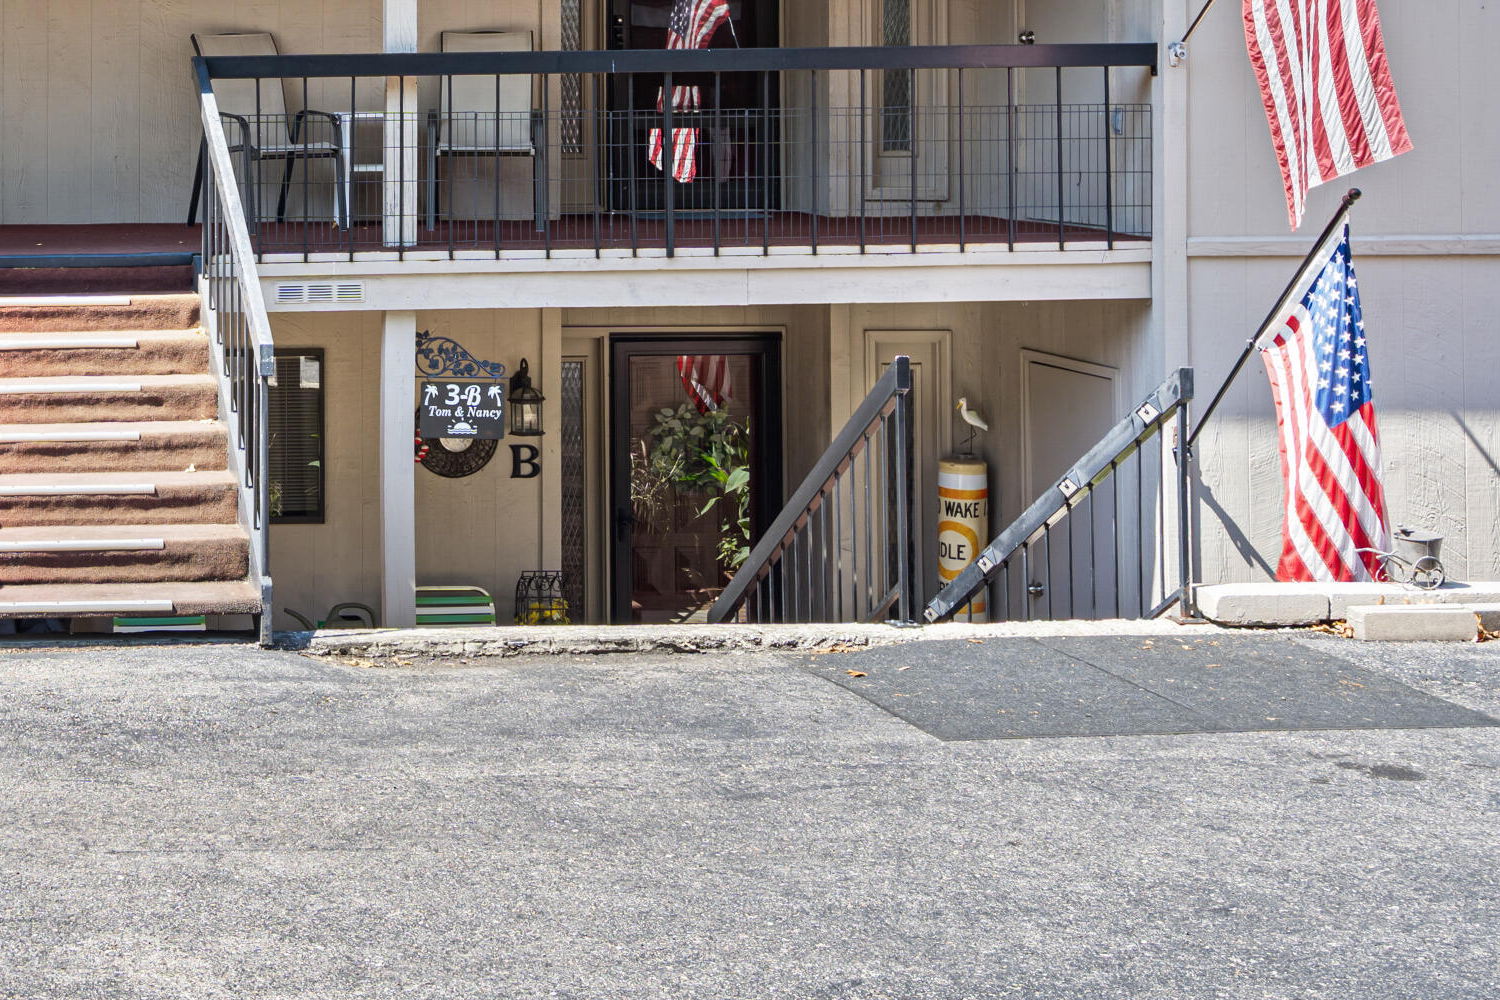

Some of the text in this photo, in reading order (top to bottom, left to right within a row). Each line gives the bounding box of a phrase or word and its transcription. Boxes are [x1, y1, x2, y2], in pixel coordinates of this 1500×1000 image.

[445, 384, 482, 406] 3-B
[428, 405, 502, 420] Tom & Nancy
[509, 444, 541, 479] B
[944, 500, 980, 518] WAKE
